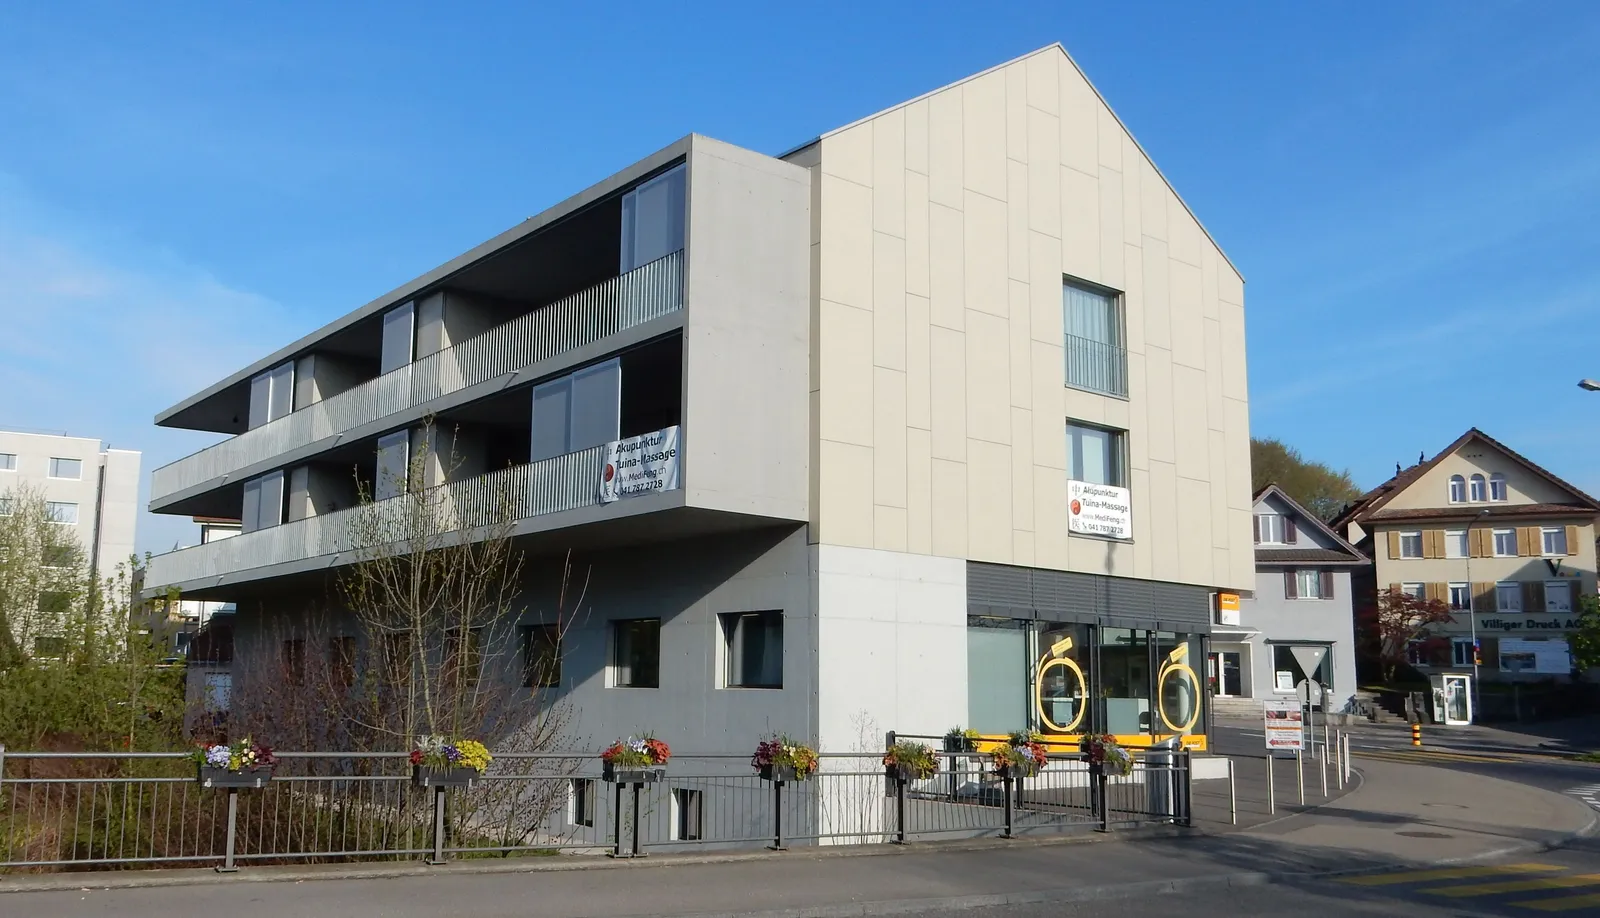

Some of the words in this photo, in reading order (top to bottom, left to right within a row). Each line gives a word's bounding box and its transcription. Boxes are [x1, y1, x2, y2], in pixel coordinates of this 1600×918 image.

[616, 436, 663, 455] Akupunktur
[615, 448, 676, 471] Tuina-Massage
[620, 485, 630, 496] 041
[632, 483, 644, 493] 787
[645, 479, 663, 490] 2728
[1083, 486, 1119, 499] Akupunktur
[1082, 498, 1128, 514] Tuina-Massage
[1482, 618, 1522, 631] Villiger
[1526, 618, 1561, 629] Druck
